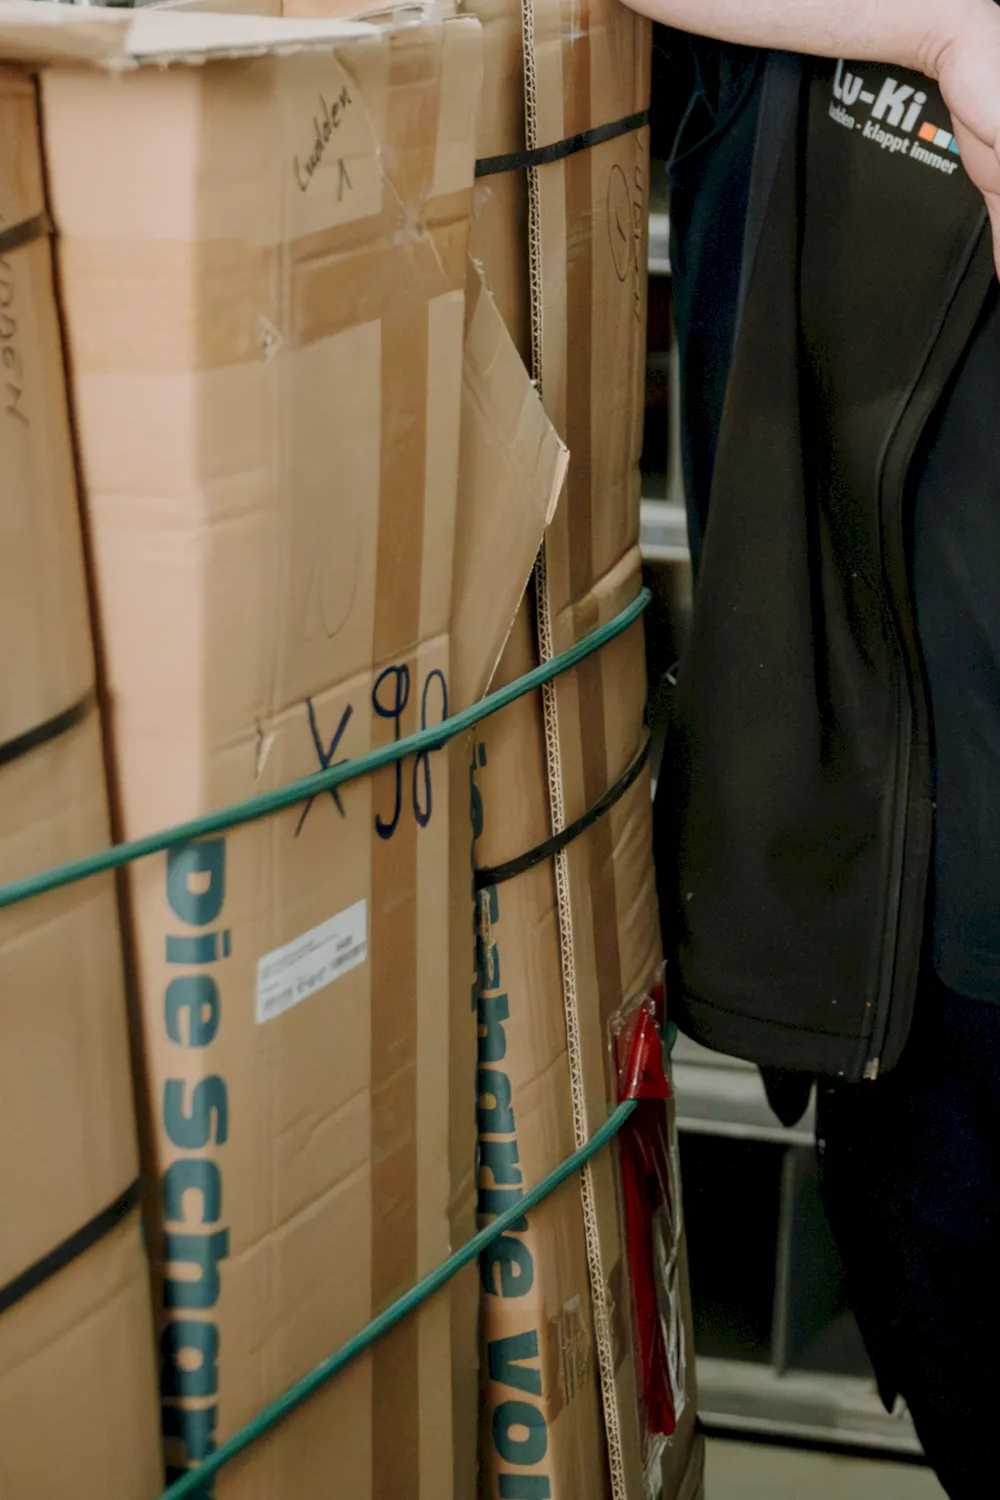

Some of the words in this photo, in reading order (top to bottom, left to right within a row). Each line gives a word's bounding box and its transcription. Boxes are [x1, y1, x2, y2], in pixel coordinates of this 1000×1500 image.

[862, 120, 911, 154] klappt
[909, 140, 958, 175] immer
[163, 836, 232, 1050] Die
